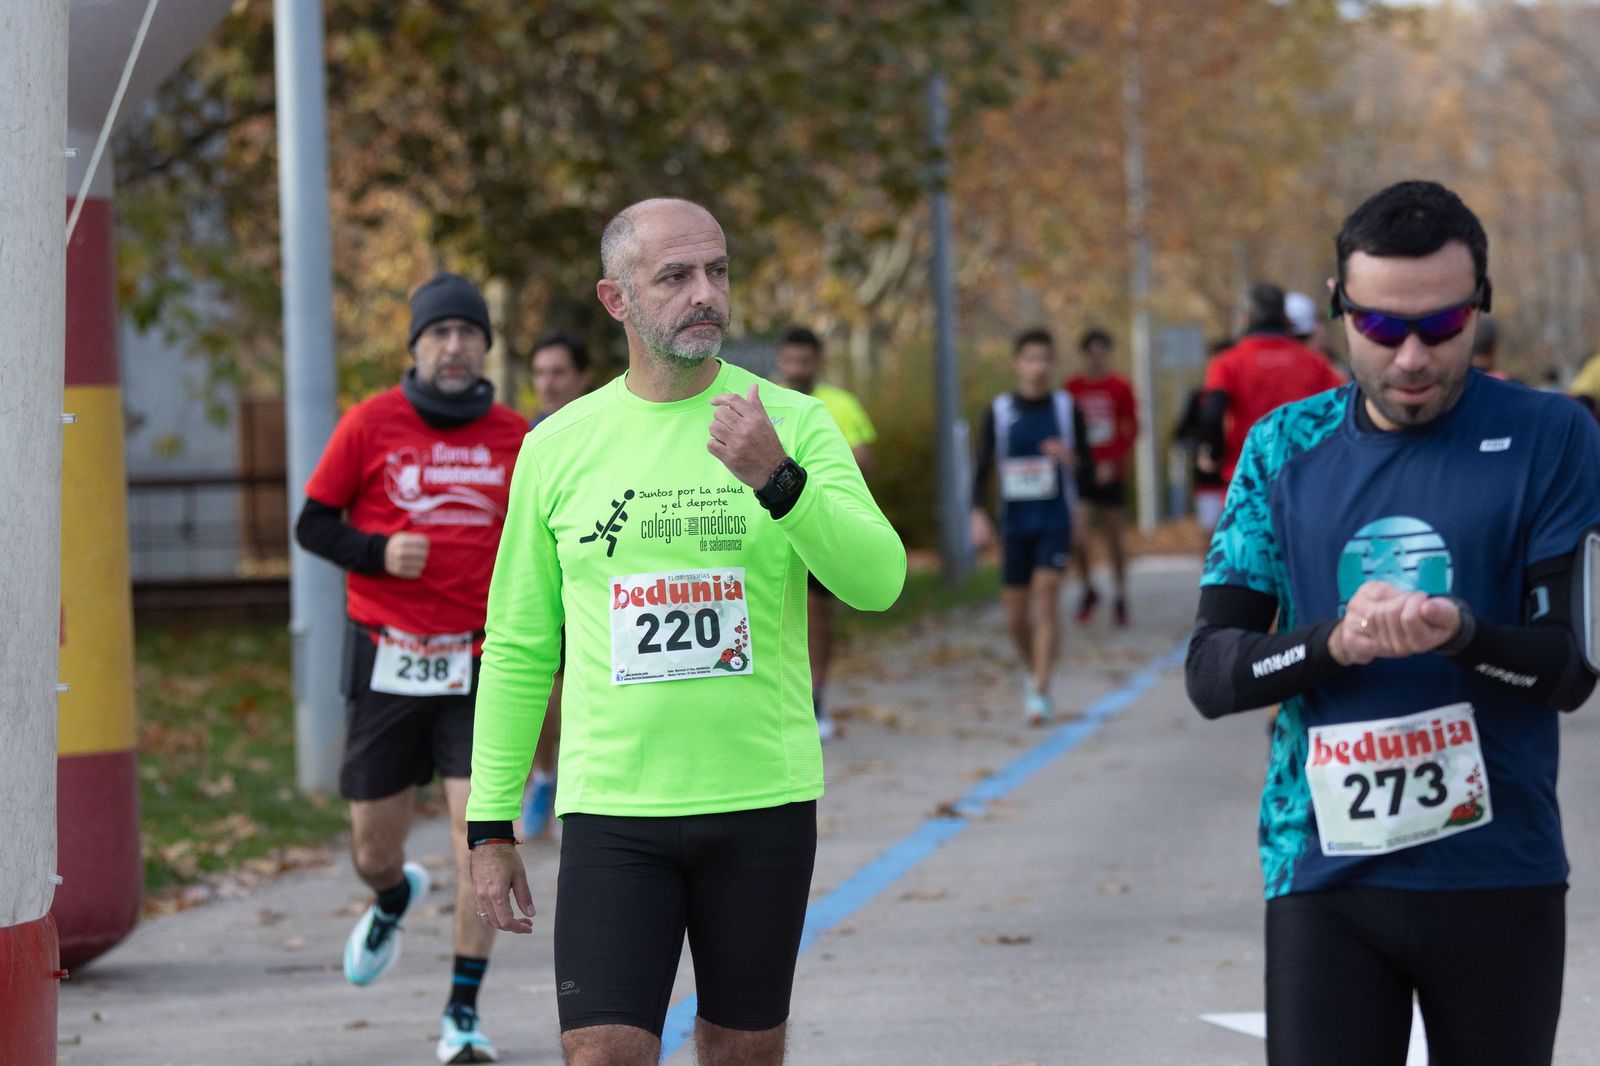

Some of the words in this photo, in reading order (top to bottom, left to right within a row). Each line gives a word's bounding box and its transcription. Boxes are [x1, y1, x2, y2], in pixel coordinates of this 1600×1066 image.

[639, 489, 673, 499] Juntos
[677, 487, 696, 501] por
[716, 485, 745, 495] salud
[661, 505, 668, 514] y
[671, 500, 682, 509] el
[686, 498, 729, 511] deporte
[640, 512, 682, 544] colegio
[700, 509, 747, 536] médicos
[699, 537, 708, 552] de
[709, 536, 742, 552] salamanca
[613, 575, 744, 610] bedunia
[667, 572, 710, 582] FLORISTERÍAS
[635, 607, 721, 655] 220
[397, 655, 449, 682] 238
[1252, 643, 1306, 679] KIPRUN
[1312, 719, 1473, 767] bedunia
[1343, 762, 1448, 820] 273
